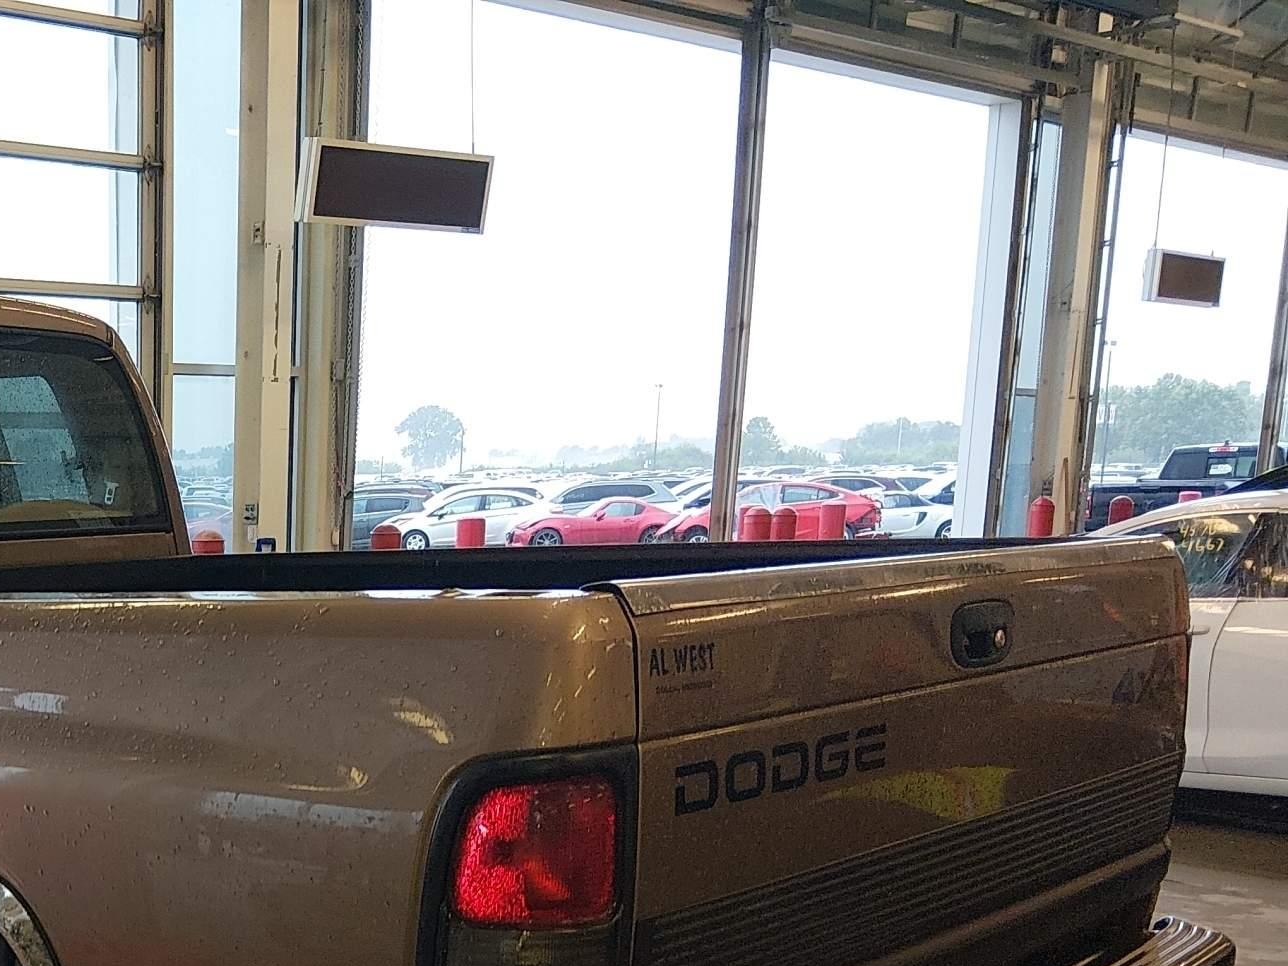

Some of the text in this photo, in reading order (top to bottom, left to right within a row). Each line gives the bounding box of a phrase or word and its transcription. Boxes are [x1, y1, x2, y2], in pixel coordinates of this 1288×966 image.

[650, 642, 715, 676] AL WEST
[675, 722, 888, 816] DODGE
